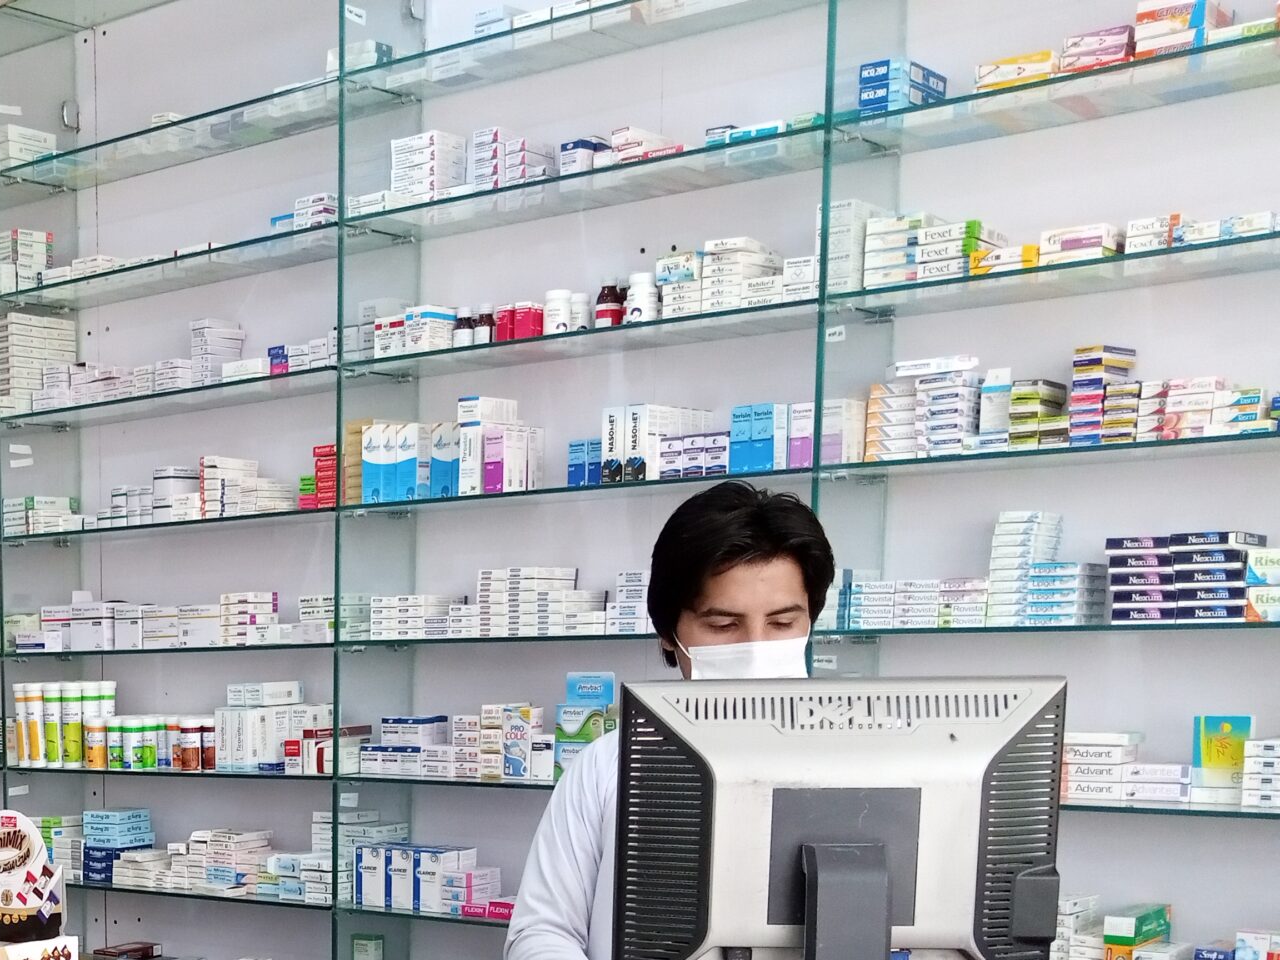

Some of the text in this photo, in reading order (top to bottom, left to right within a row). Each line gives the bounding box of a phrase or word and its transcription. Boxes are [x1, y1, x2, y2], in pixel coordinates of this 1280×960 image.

[924, 229, 952, 241] Fexet
[921, 246, 949, 258] Fexet
[922, 263, 950, 275] Fexet
[1188, 535, 1219, 543] Nexum
[1123, 540, 1153, 548] Nexum
[1128, 558, 1158, 566] Nexum
[1192, 553, 1225, 562] Nexum
[1129, 576, 1159, 584] Nexum
[1194, 572, 1226, 581] Nexum
[864, 582, 893, 590] Rovista
[863, 595, 892, 603] Rovista
[1132, 593, 1163, 602] Nexum
[1197, 590, 1229, 599] Nexum
[863, 607, 892, 615] Rovista
[953, 605, 983, 613] Rovista
[1195, 608, 1227, 617] Nexum
[1130, 611, 1161, 619] Nexum
[863, 619, 891, 627] Rovista
[952, 618, 983, 626] Rovista
[505, 732, 527, 741] COLIC
[1074, 749, 1112, 758] Advant
[1075, 766, 1112, 776] Advant
[1075, 784, 1113, 793] Advant
